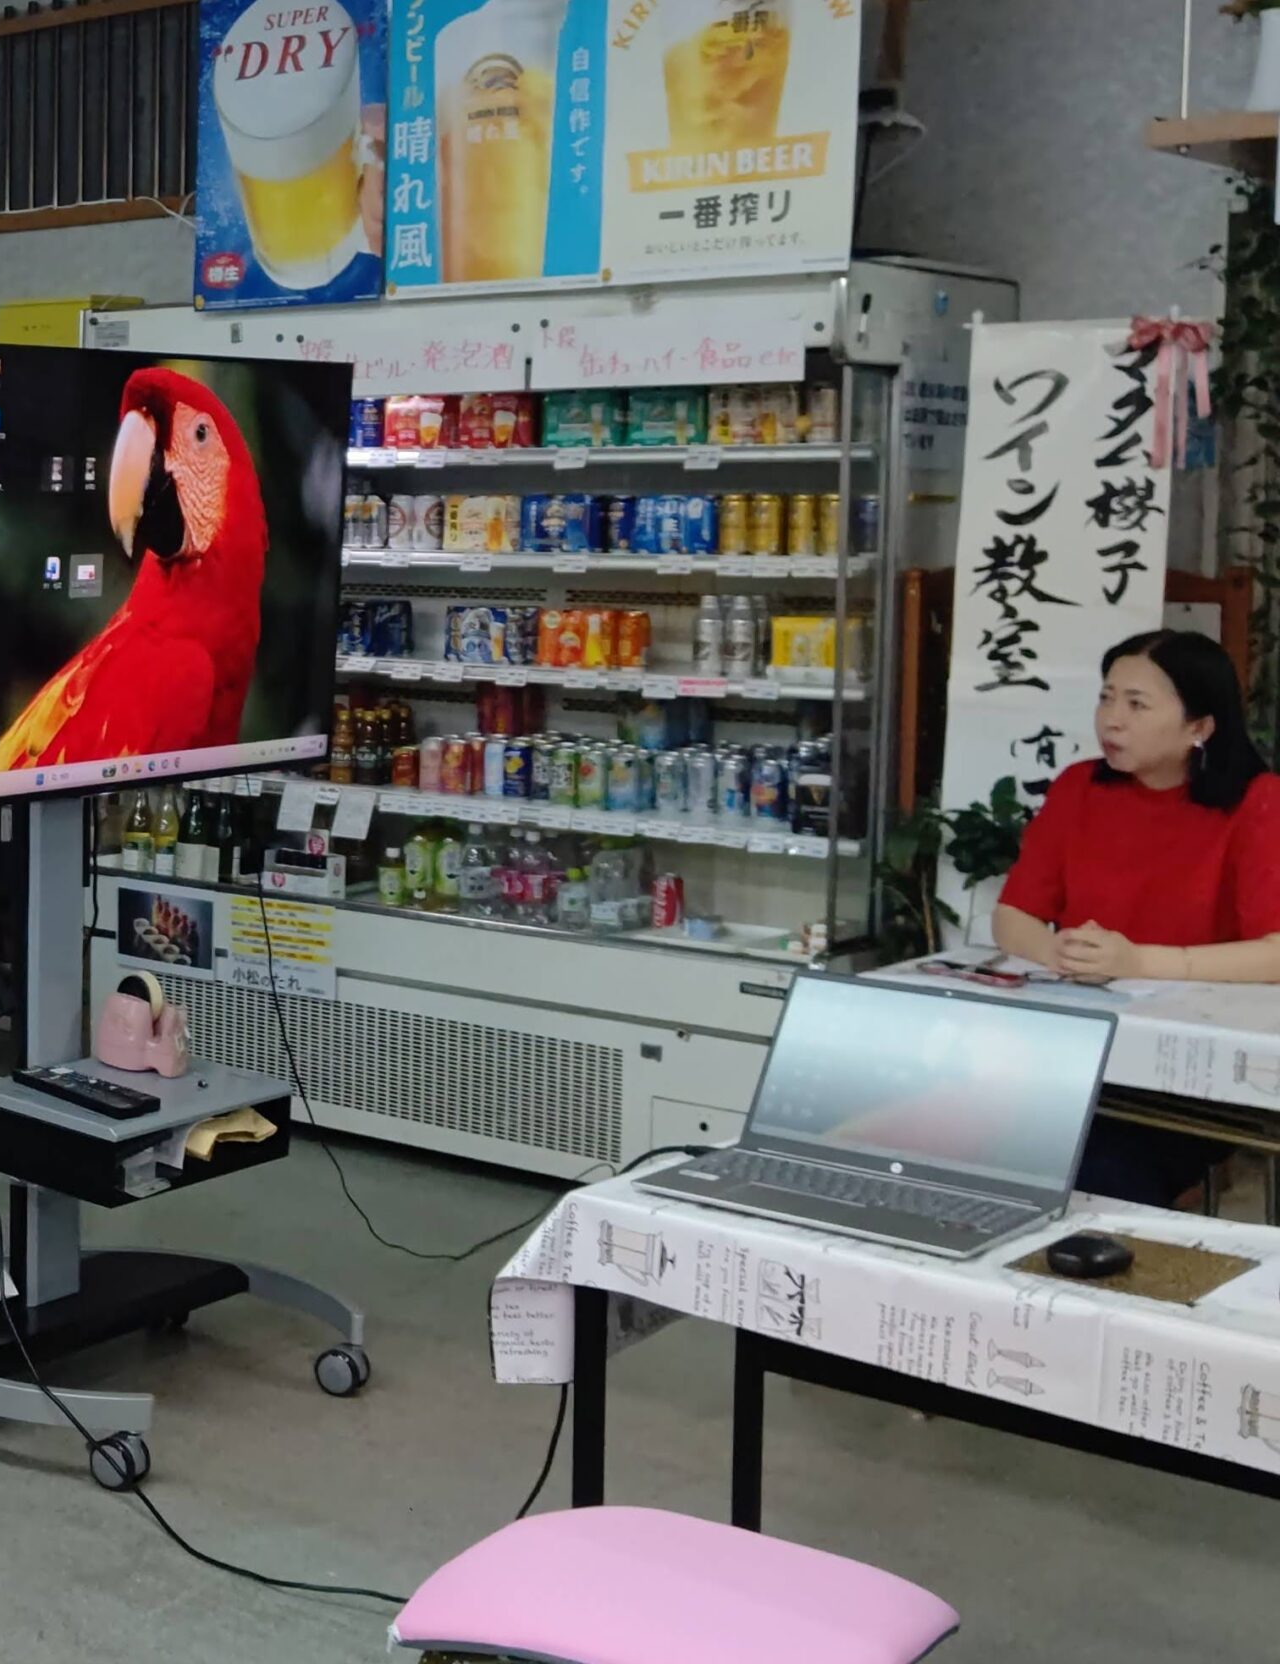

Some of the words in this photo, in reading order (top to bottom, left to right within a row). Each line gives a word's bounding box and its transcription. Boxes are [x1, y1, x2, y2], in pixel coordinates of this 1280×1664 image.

[264, 6, 329, 31] SUPER
[642, 151, 730, 184] KIRIN
[735, 142, 815, 175] BEER
[393, 116, 433, 270] 晴れ風
[968, 368, 1083, 692] ワイン教室
[232, 966, 302, 991] 小松のたれ
[734, 1247, 750, 1292] Special
[1195, 1361, 1213, 1412] Coffee
